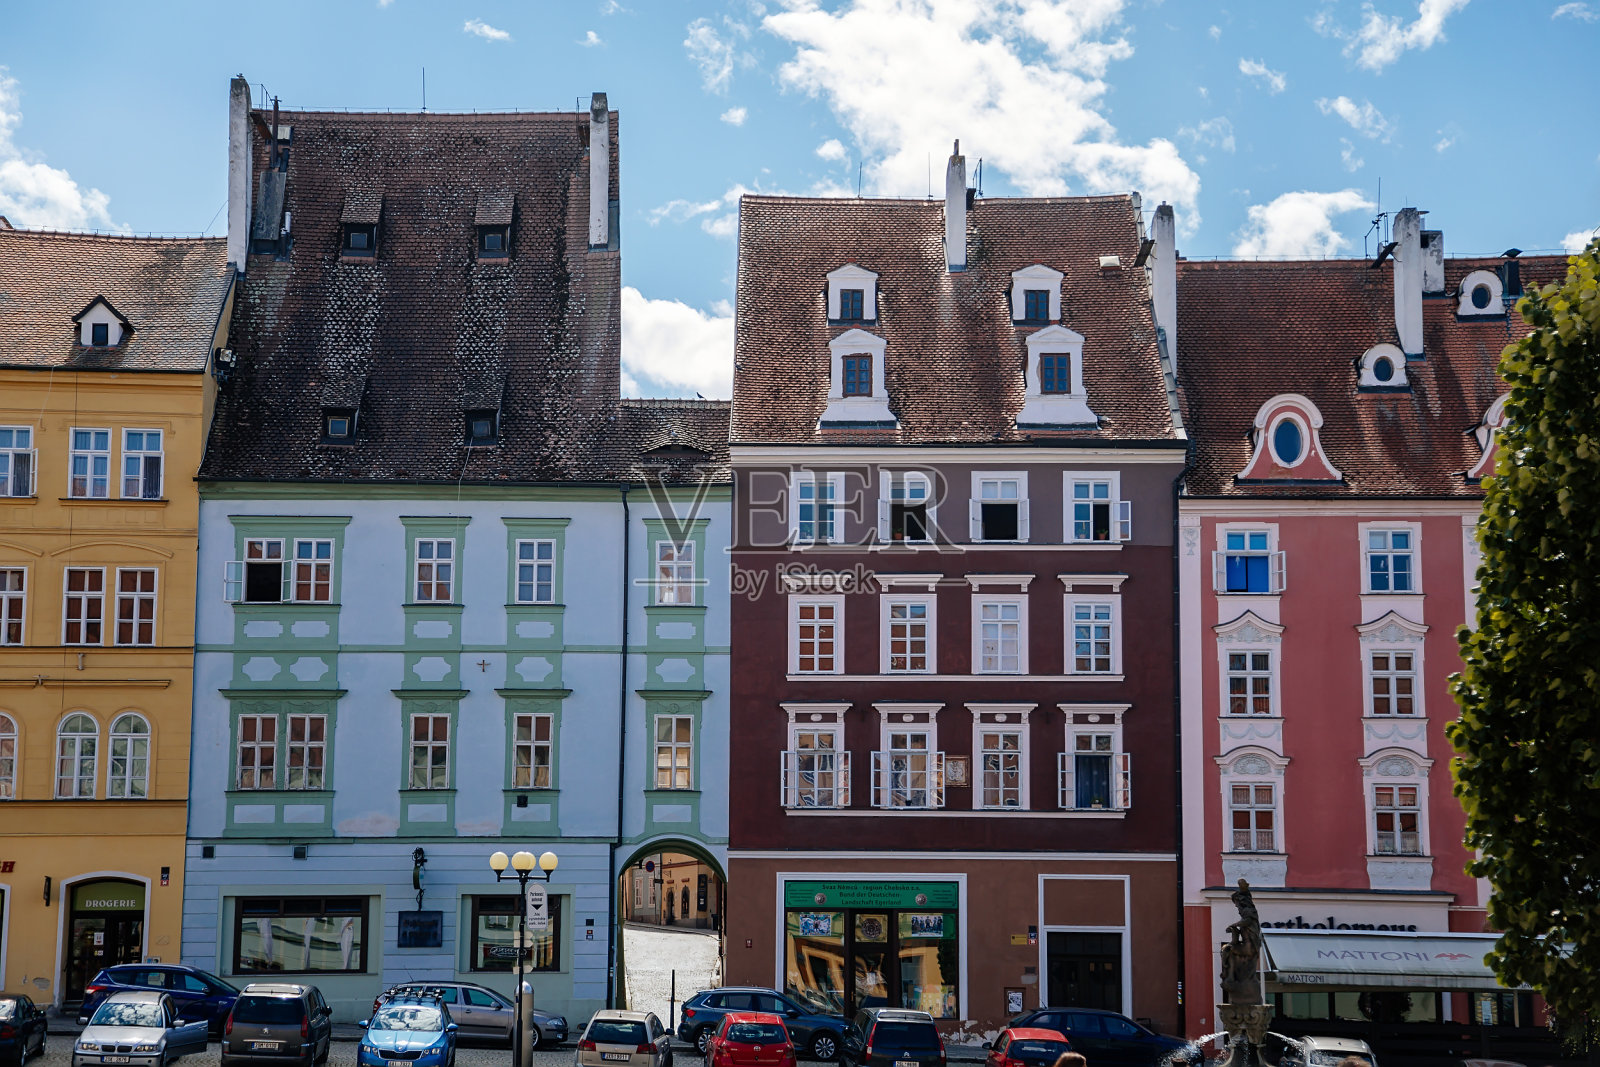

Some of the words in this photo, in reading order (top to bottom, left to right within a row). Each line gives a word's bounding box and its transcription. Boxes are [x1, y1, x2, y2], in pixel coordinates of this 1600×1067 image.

[85, 899, 136, 908] DROGERIE
[1260, 916, 1417, 932] artholomeus
[1317, 949, 1431, 963] MATTONI
[1287, 974, 1325, 984] MATTONI
